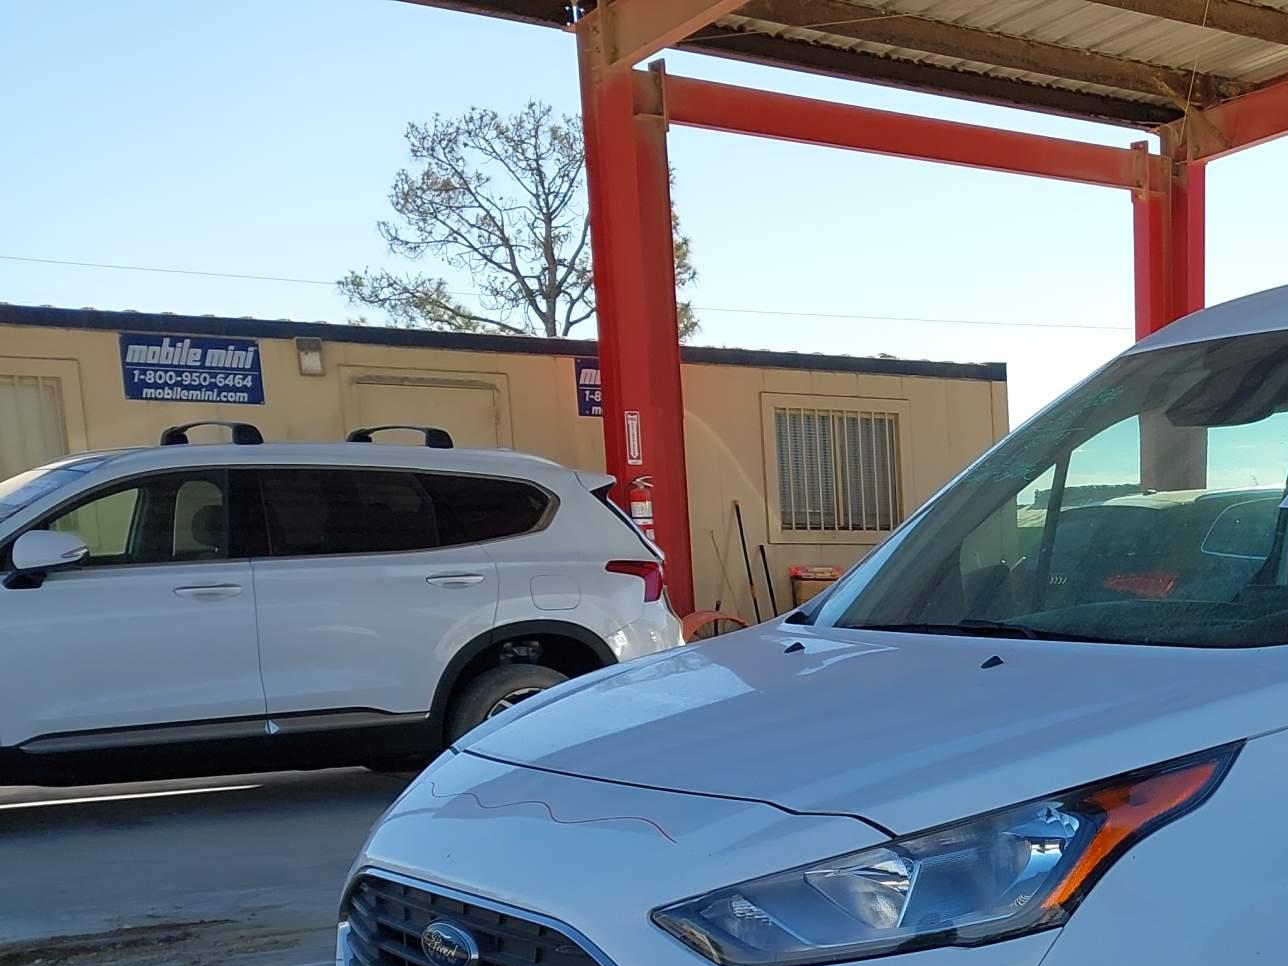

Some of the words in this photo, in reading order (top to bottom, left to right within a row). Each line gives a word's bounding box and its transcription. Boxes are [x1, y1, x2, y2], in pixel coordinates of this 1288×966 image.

[125, 337, 202, 365] mobile
[204, 345, 255, 369] mini
[133, 370, 253, 388] 1-800-950-6464
[142, 386, 249, 402] mobilemini.com
